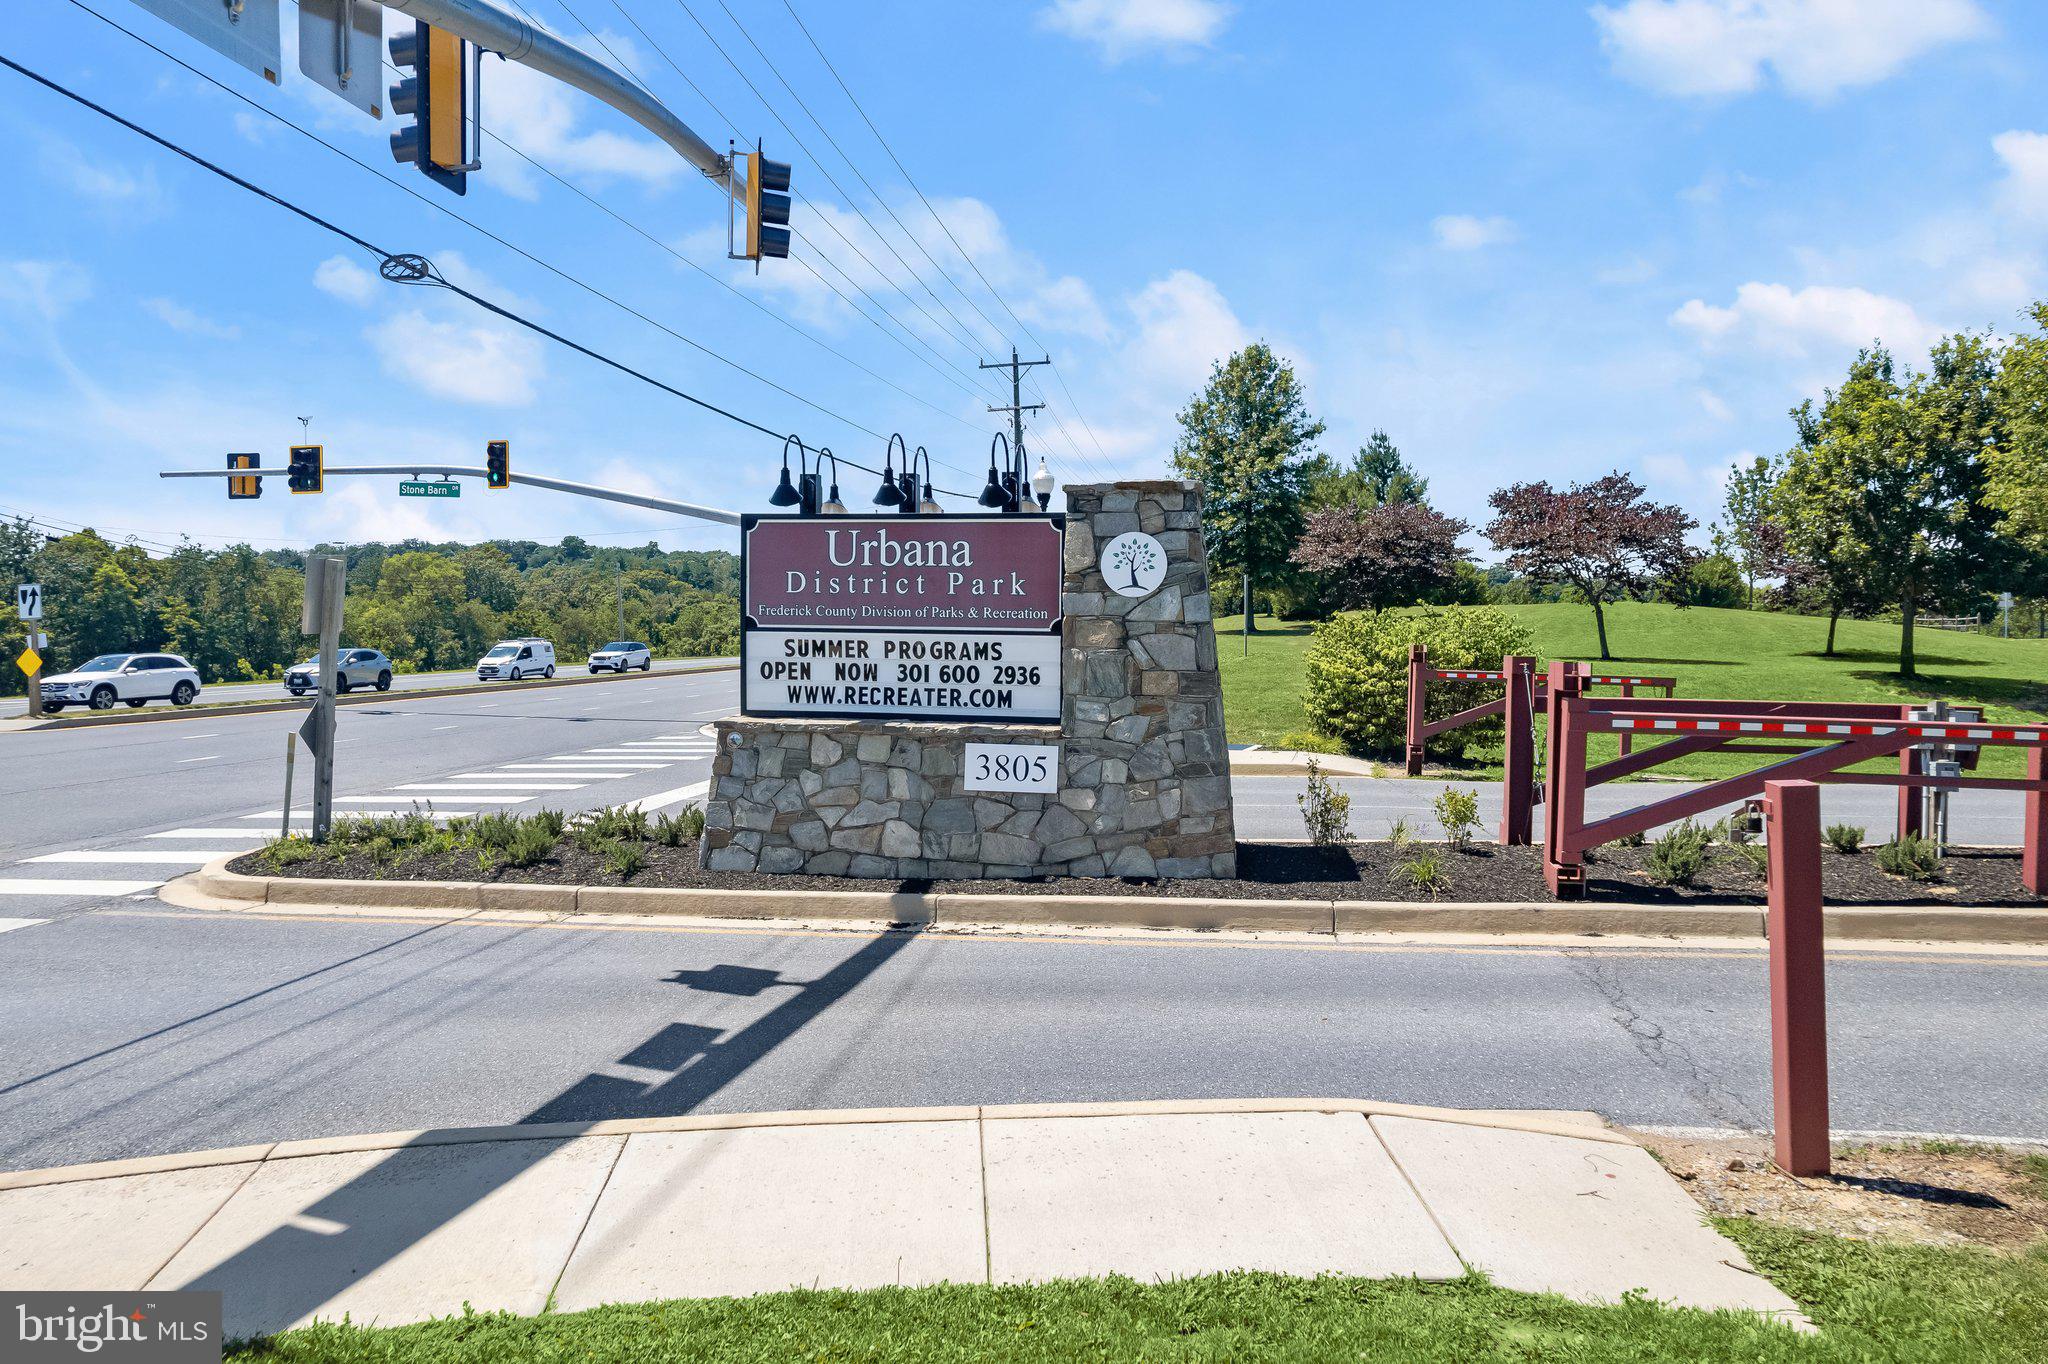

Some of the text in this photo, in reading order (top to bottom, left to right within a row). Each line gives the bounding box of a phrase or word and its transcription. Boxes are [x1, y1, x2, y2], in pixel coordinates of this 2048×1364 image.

[401, 485, 425, 494] Stone
[427, 485, 448, 495] Barn
[824, 528, 974, 567] Urbana
[786, 570, 1027, 596] District Park
[758, 604, 1049, 620] Frederick County Division of Parks & Recreation
[784, 638, 1003, 661] SUMMER PROGRAMS
[760, 661, 1041, 686] OPEN NOW 301 600 2936
[787, 685, 1013, 709] WWW.RECREATER.COM
[975, 753, 1047, 783] 3805
